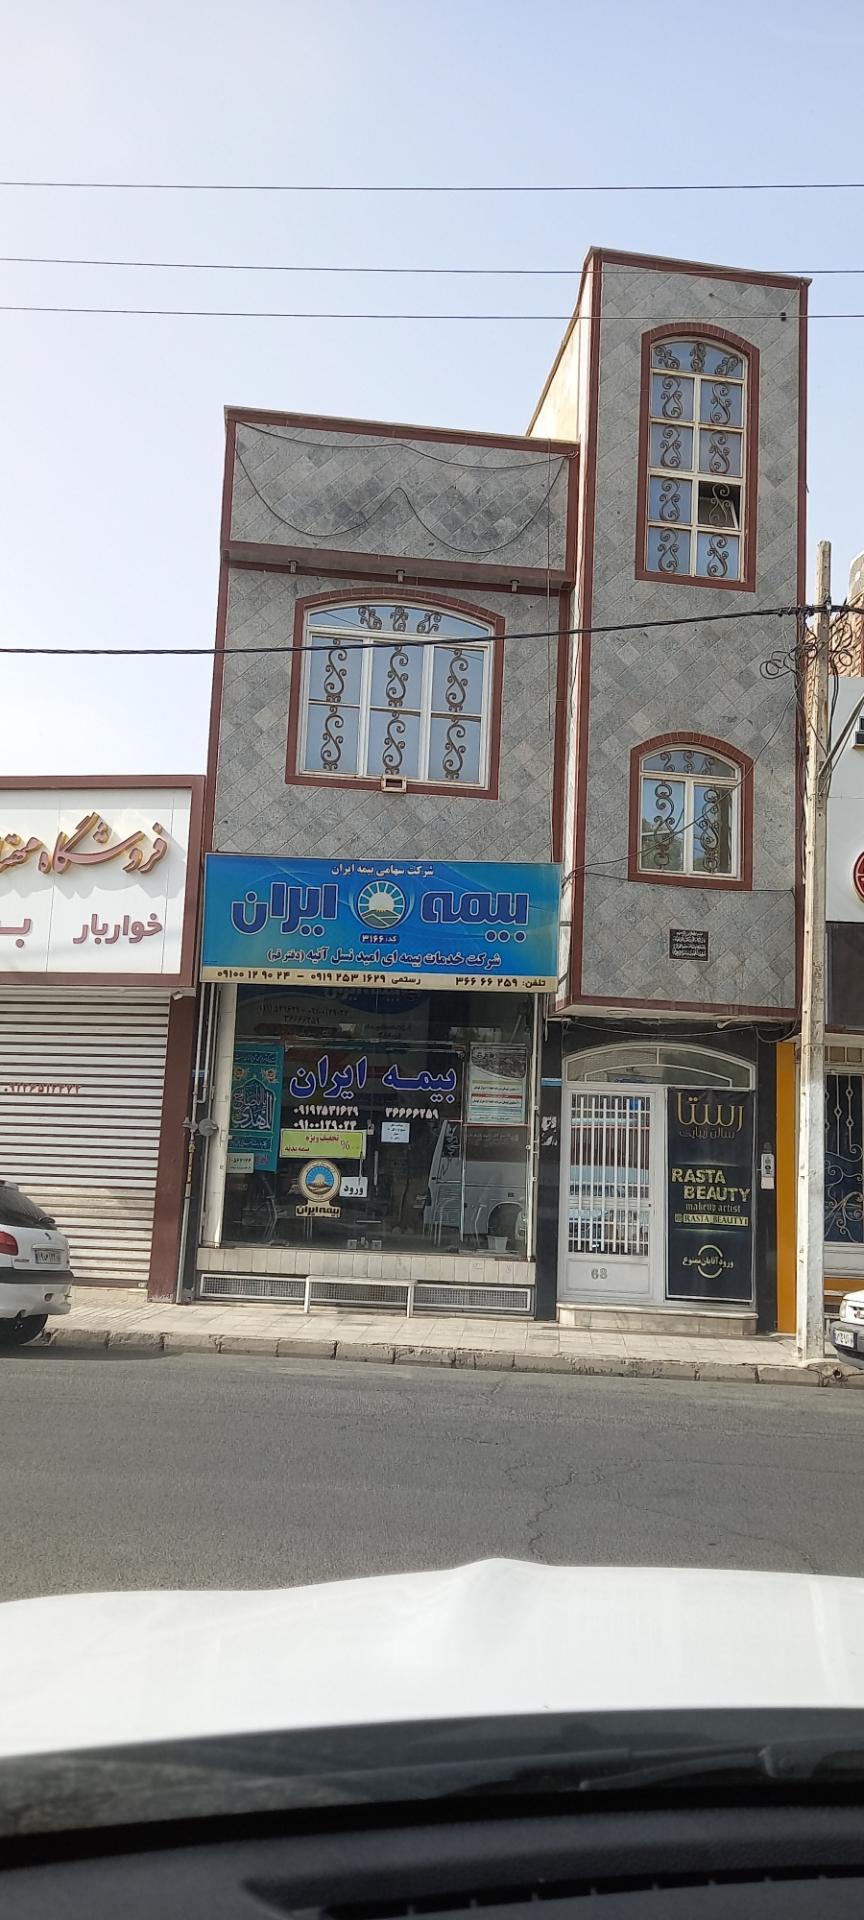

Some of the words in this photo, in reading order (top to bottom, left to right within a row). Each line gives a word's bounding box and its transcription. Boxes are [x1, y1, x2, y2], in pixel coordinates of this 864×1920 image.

[38, 812, 168, 874] فروشگاه
[331, 863, 355, 875] ایران
[357, 864, 374, 876] بیمه
[377, 865, 405, 877] سهامی
[407, 865, 434, 877] شرکت
[231, 881, 339, 937] ایران
[421, 890, 529, 943] بیمه
[72, 912, 164, 945] خواربار
[361, 933, 384, 943] ۳۱۶۶
[331, 946, 354, 965] نسل
[356, 948, 380, 966] امید
[381, 949, 398, 967] ای
[400, 954, 421, 967] بیمه
[424, 950, 464, 966] خدمات
[466, 952, 502, 970] شرکت
[217, 970, 244, 979] ۰۹۱۰۰
[248, 970, 259, 980] ۱۲
[261, 971, 273, 980] ۹۰
[276, 971, 290, 981] ۲۴
[311, 973, 332, 982] ۰۹۱۹
[336, 974, 359, 983] ۲۵۳
[363, 974, 386, 984] ۱۶۲۹
[392, 976, 421, 986] رستمی
[455, 976, 477, 986] ۳۶۶
[480, 977, 493, 987] ۶۶
[497, 977, 518, 988] ۲۵۹
[522, 979, 546, 988] تلفن:
[289, 1054, 367, 1099] ایران
[381, 1062, 457, 1103] بیمه
[293, 1104, 359, 1118] ۰۹۱۹۲۵۳۱۶۲۹
[385, 1107, 439, 1120] ۳۶۶۶۶۲۵۹
[677, 1092, 744, 1133] رستا
[671, 1168, 726, 1184] RASTA
[344, 1184, 364, 1195] ورود
[683, 1186, 751, 1202] BEAUTY
[296, 1206, 318, 1216] ایران
[319, 1206, 340, 1217] بیمه
[685, 1202, 717, 1213] makeup
[718, 1203, 741, 1213] artist
[719, 1258, 734, 1268] ورود
